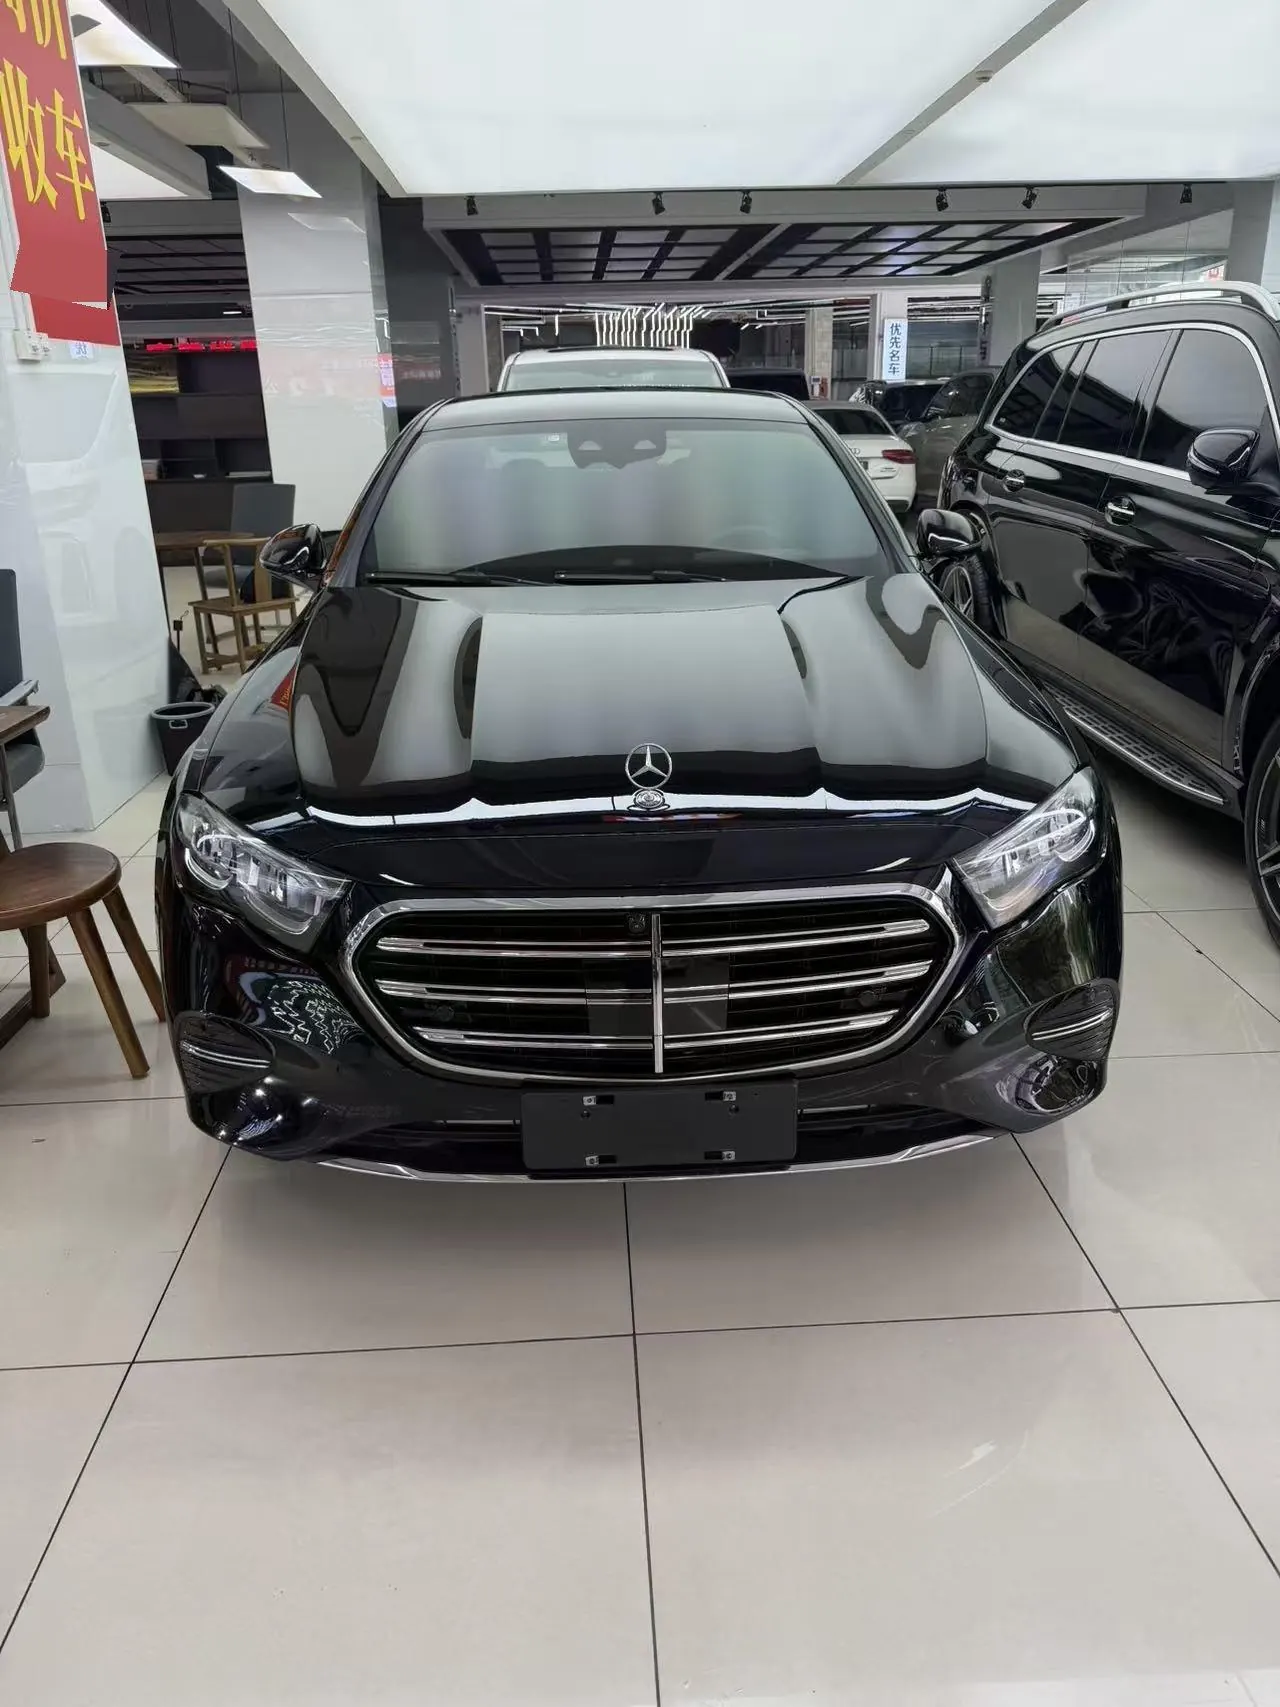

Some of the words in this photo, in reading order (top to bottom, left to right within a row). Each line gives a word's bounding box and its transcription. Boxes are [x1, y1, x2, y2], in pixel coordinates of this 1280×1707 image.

[0, 57, 95, 220] 收车
[888, 322, 902, 375] 优先名车
